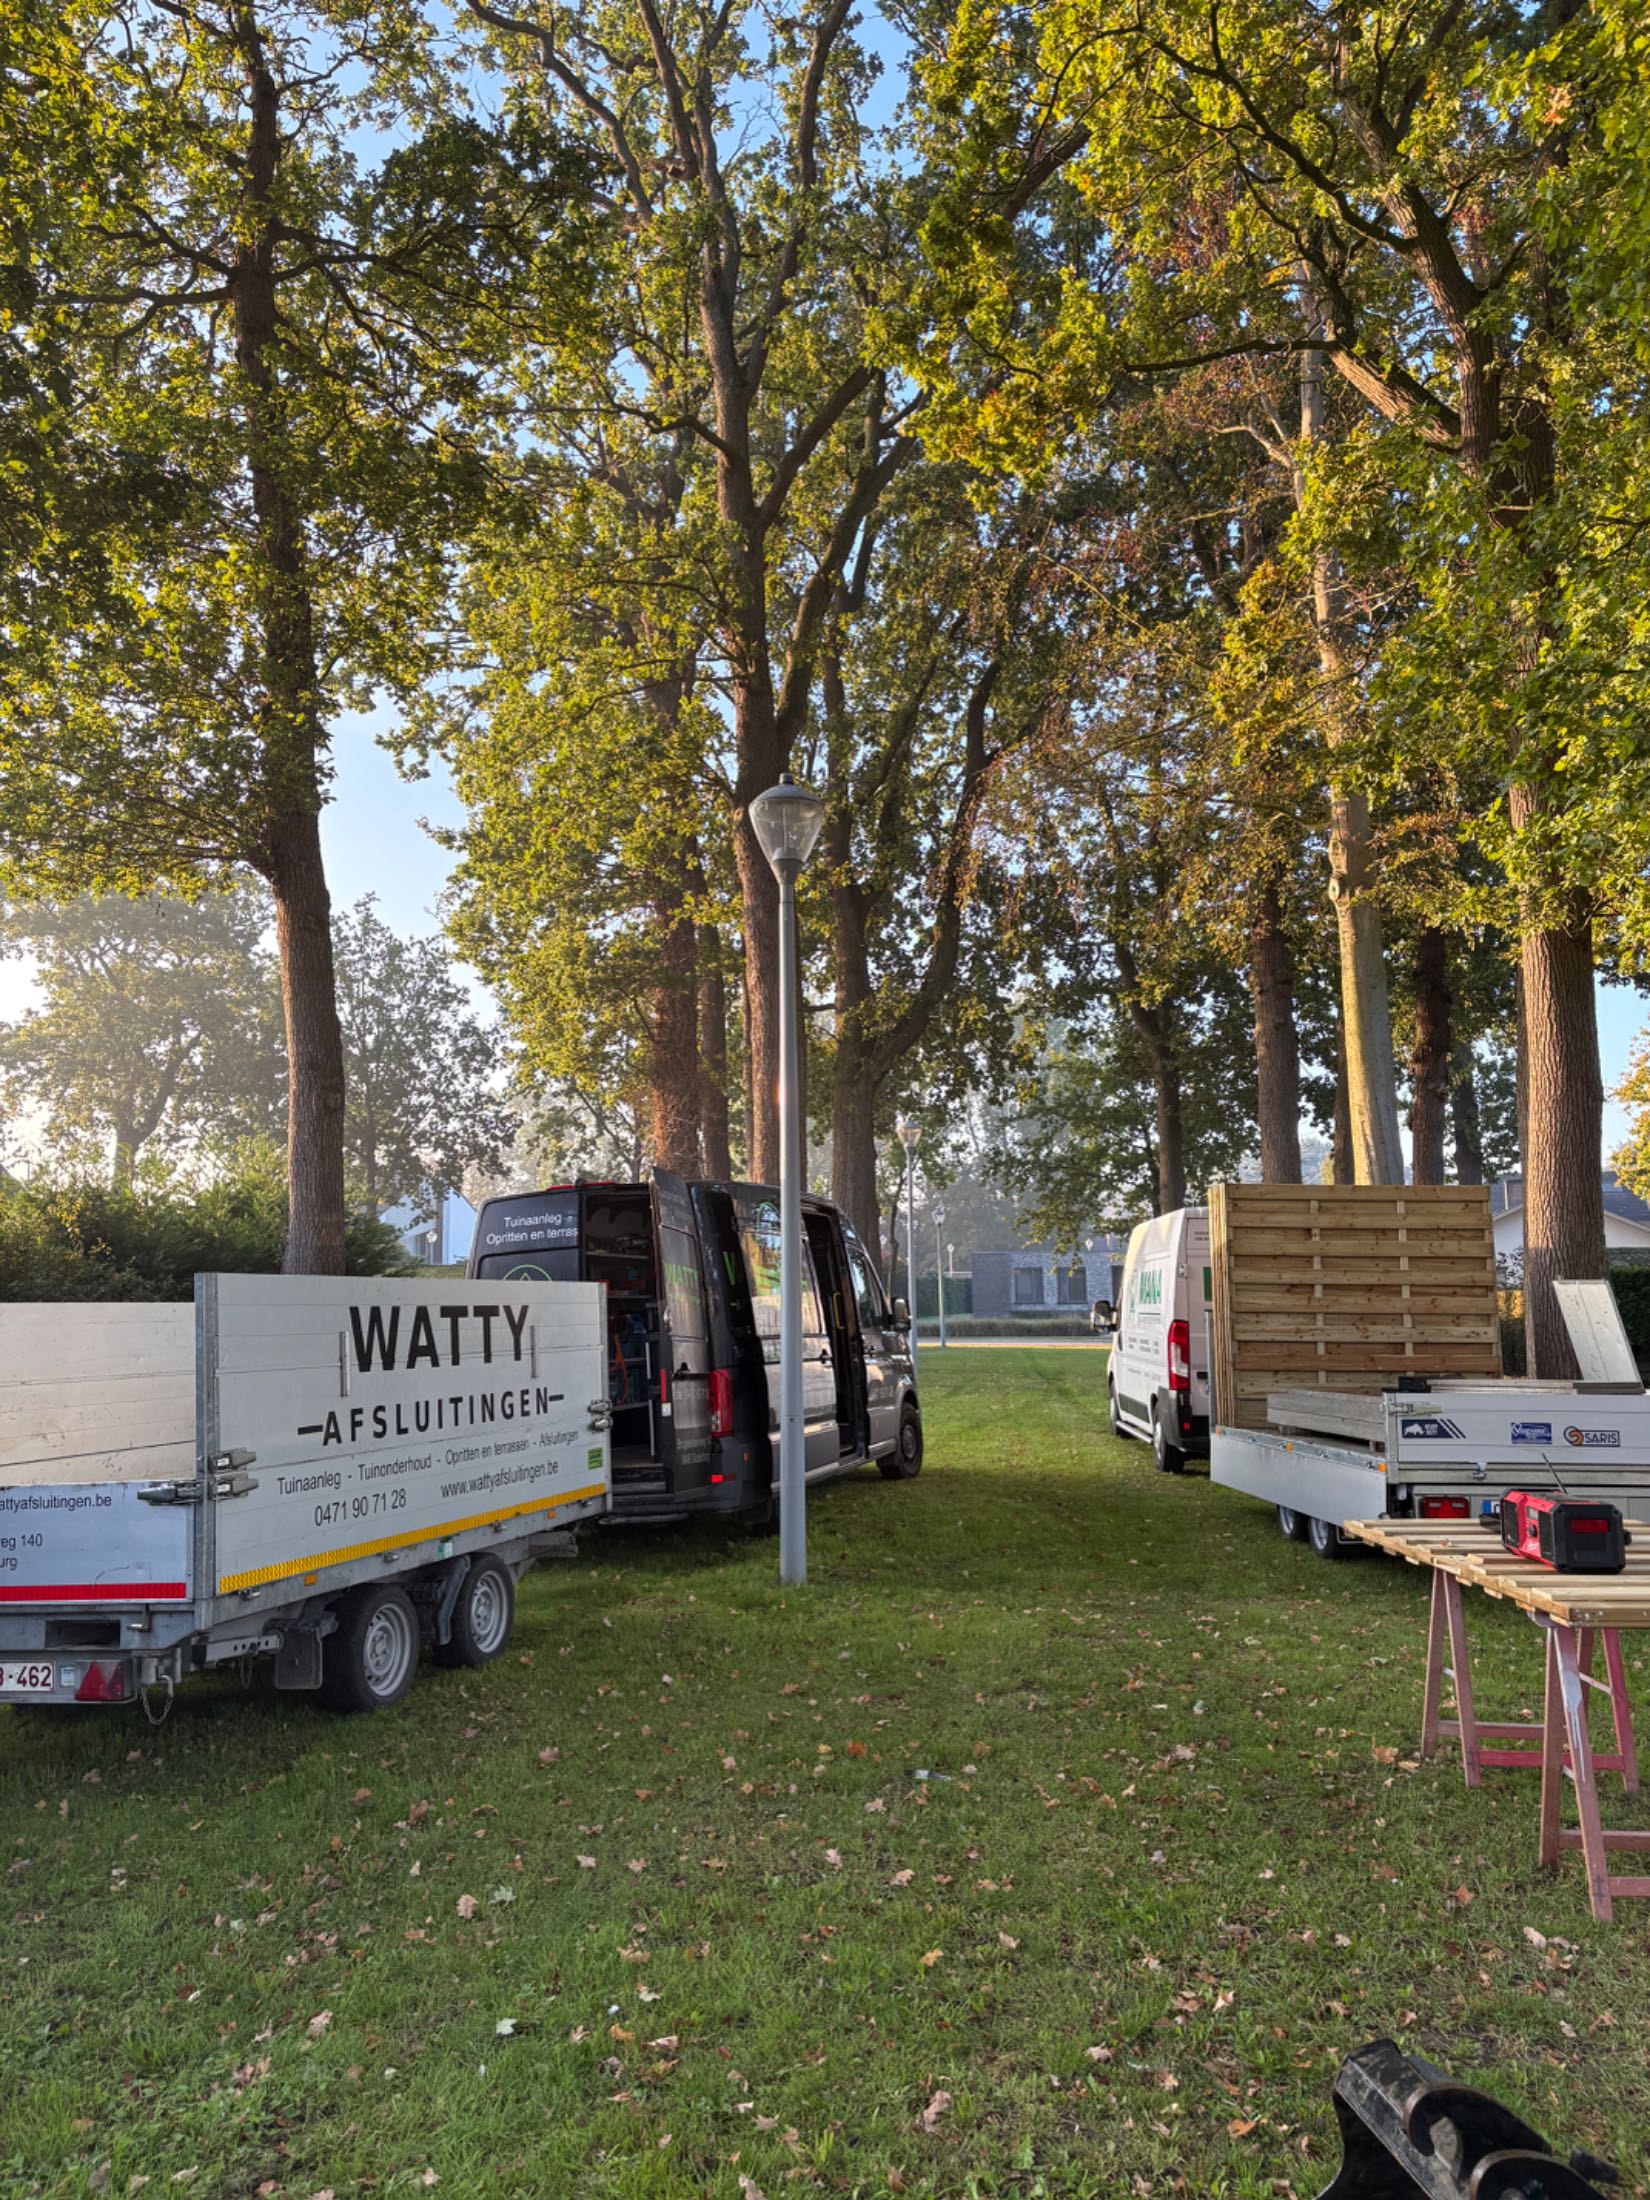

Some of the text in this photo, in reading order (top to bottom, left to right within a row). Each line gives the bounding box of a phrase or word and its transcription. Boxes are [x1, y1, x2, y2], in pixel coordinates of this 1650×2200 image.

[504, 1213, 563, 1228] Tuinaanleg
[486, 1231, 528, 1245] Opritten
[530, 1231, 545, 1240] en
[349, 1305, 529, 1372] WATTY
[1584, 1432, 1617, 1444] SARIS
[277, 1471, 342, 1495] Tuinaanleg
[358, 1455, 432, 1481] Tuinonderhoud
[445, 1448, 480, 1467] Opritten
[482, 1446, 492, 1459] en
[493, 1440, 529, 1454] terrassen
[539, 1431, 578, 1447] Afsluitingen
[314, 1460, 559, 1526] 0471 90 71 28 www.wattyafsluitingen.be
[20, 1533, 43, 1547] 140
